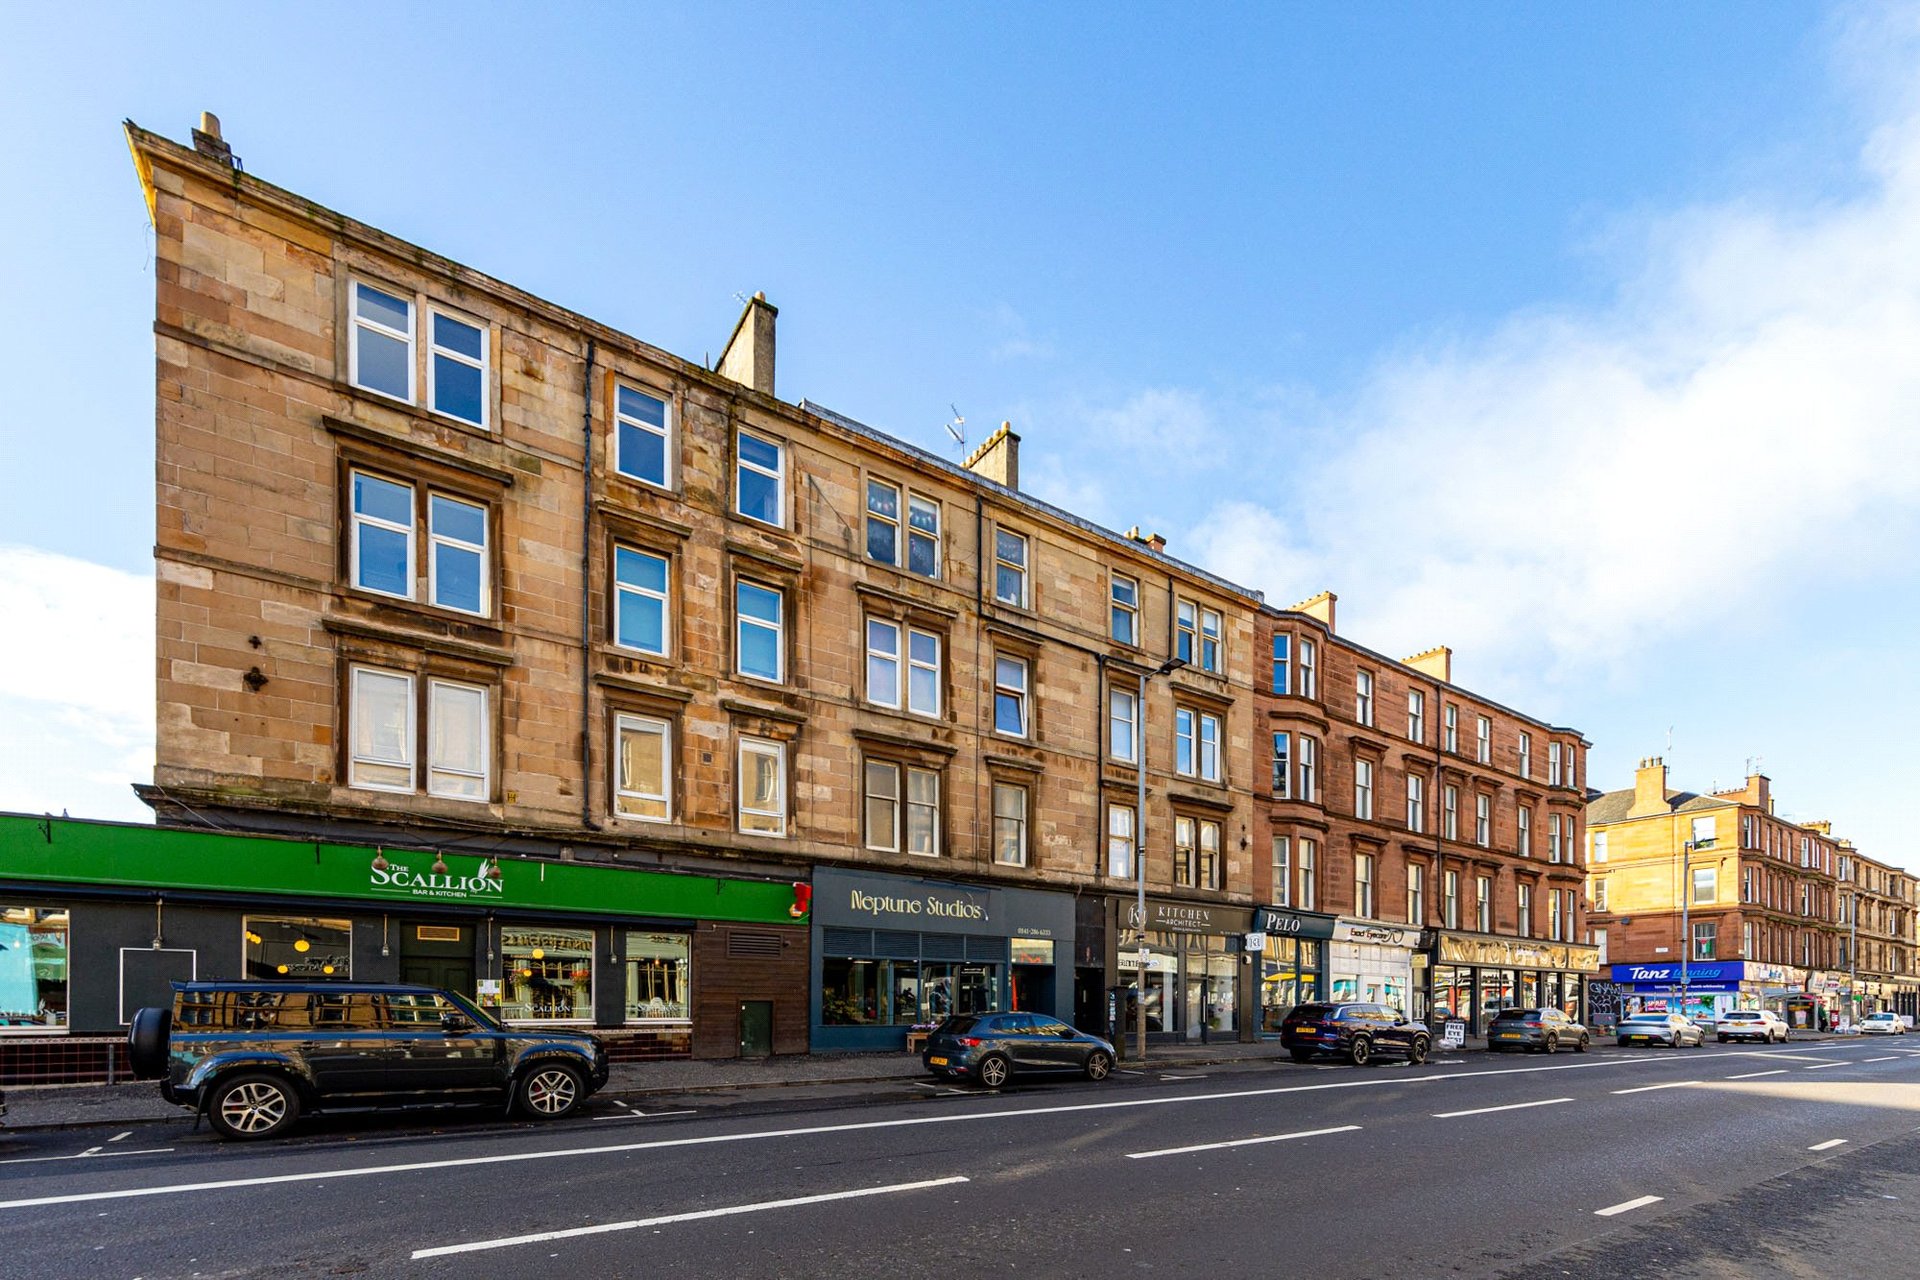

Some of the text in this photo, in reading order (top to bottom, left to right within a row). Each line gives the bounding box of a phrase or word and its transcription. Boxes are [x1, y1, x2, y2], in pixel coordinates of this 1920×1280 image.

[390, 863, 409, 872] THE
[370, 864, 504, 892] SCALLION
[851, 889, 982, 919] Neptune Studios
[1158, 906, 1210, 920] KITCHEN
[1165, 919, 1201, 928] ARCHITECT
[1266, 912, 1300, 932] PELO
[1629, 966, 1671, 980] Tanz
[524, 1002, 571, 1013] SCALLION
